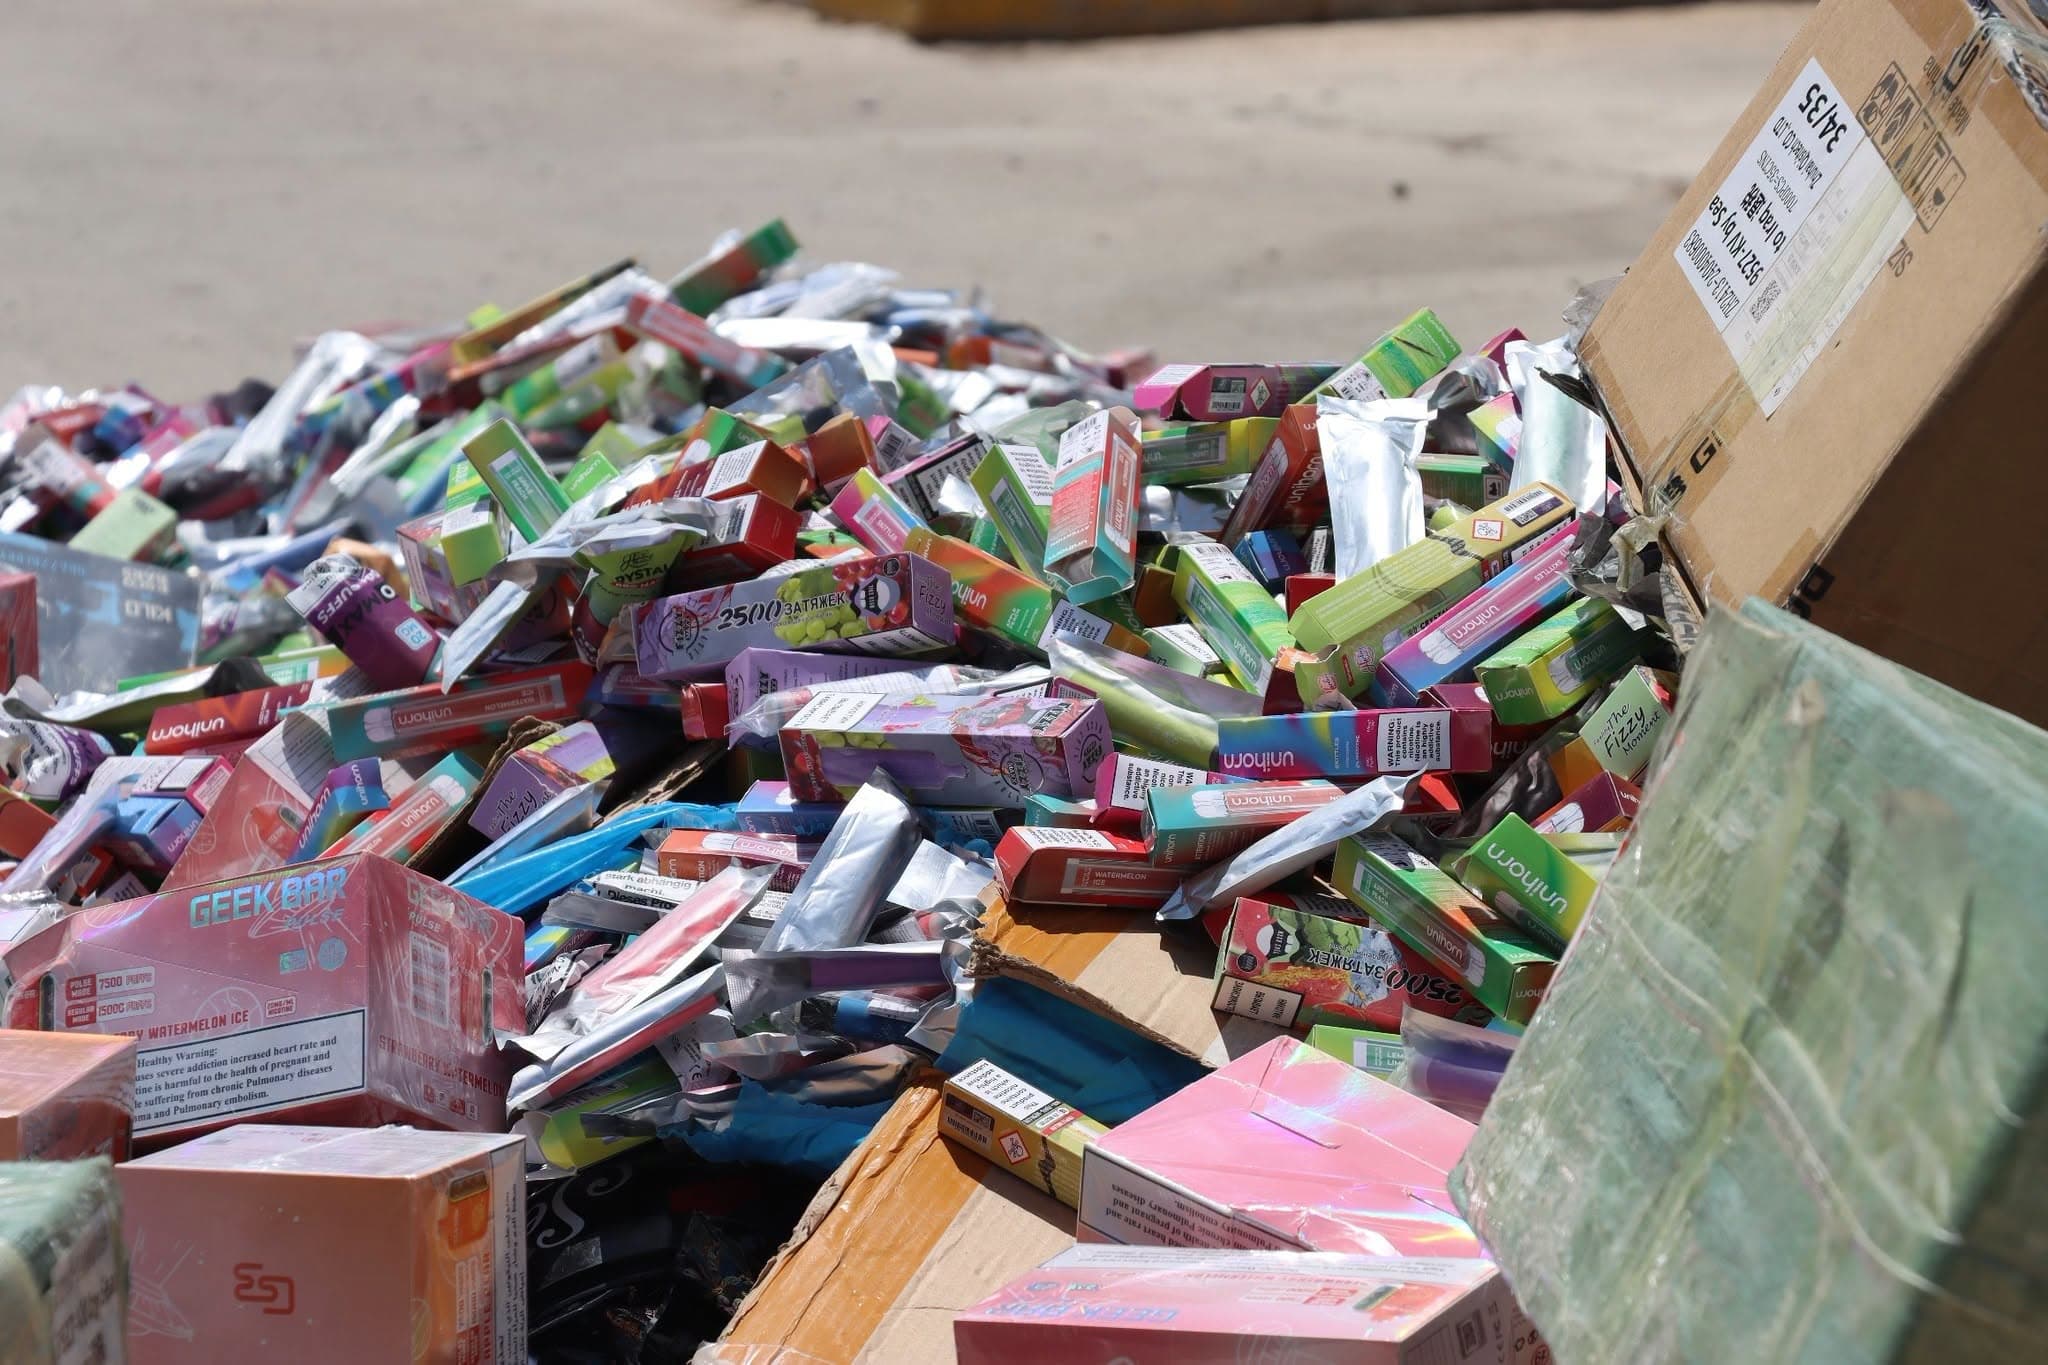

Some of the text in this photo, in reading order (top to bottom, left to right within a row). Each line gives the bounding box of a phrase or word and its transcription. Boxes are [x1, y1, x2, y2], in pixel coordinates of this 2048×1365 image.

[1798, 83, 1847, 153] 34/35
[1709, 194, 1764, 287] 9527-KV by Sea
[1772, 230, 1787, 254] to
[1289, 455, 1322, 504] unihorn
[1534, 558, 1564, 581] SKITTLES
[952, 580, 987, 609] uniho
[717, 600, 782, 632] 2500
[783, 591, 848, 616] ЗАТЯЖЕК
[1451, 603, 1500, 641] unihorn
[1233, 637, 1258, 671] unihorn
[1495, 687, 1534, 702] unihorn
[152, 717, 225, 741] unihorn
[398, 708, 453, 726] unihorn
[1606, 704, 1630, 731] The
[1387, 718, 1395, 767] WARNING:
[1604, 705, 1646, 759] Fizzy
[1623, 710, 1661, 757] Moment
[1224, 751, 1294, 771] unihorn
[351, 765, 369, 805] unihorn
[1124, 763, 1134, 800] substance.
[1132, 767, 1141, 799] addictive
[402, 796, 440, 828] unihorn
[1231, 792, 1293, 806] unihorn
[298, 787, 331, 849] unihorn
[167, 820, 199, 853] unihorn
[1095, 871, 1147, 881] WATERMELON
[1487, 842, 1568, 915] unihorn
[190, 867, 348, 928] GEEK BAR
[607, 889, 648, 907] Dieses
[409, 911, 441, 932] PULSE
[1427, 924, 1464, 960] unihorn
[1307, 948, 1386, 980] ЗАТЯЖЕК
[70, 978, 92, 990] PULSE
[71, 987, 91, 997] MODE
[99, 976, 122, 990] 7500
[1386, 967, 1464, 1004] 2500
[71, 1013, 91, 1024] MODE
[267, 1005, 294, 1016] NICOTINE
[149, 1017, 227, 1040] WATERMELON
[231, 1010, 249, 1024] ICE
[135, 1036, 337, 1082] uses severe addiction increased heart rate and
[135, 1050, 330, 1095] tine is harmful to the health of pregnant and
[137, 1047, 218, 1070] Healthy Warning:
[144, 1064, 333, 1110] suffering from chronic Pulmonary diseases
[976, 1076, 997, 1090] highly
[154, 1107, 170, 1119] and
[173, 1098, 222, 1116] Pulmonary
[224, 1091, 269, 1105] embolism.
[1023, 1101, 1039, 1110] This
[1111, 1183, 1146, 1206] diseases
[1112, 1198, 1130, 1210] and
[1105, 1207, 1122, 1221] and
[1124, 1216, 1143, 1229] rate
[1131, 1206, 1170, 1233] pregnant
[1149, 1201, 1196, 1231] Pulmonary
[1174, 1199, 1219, 1227] embolism.
